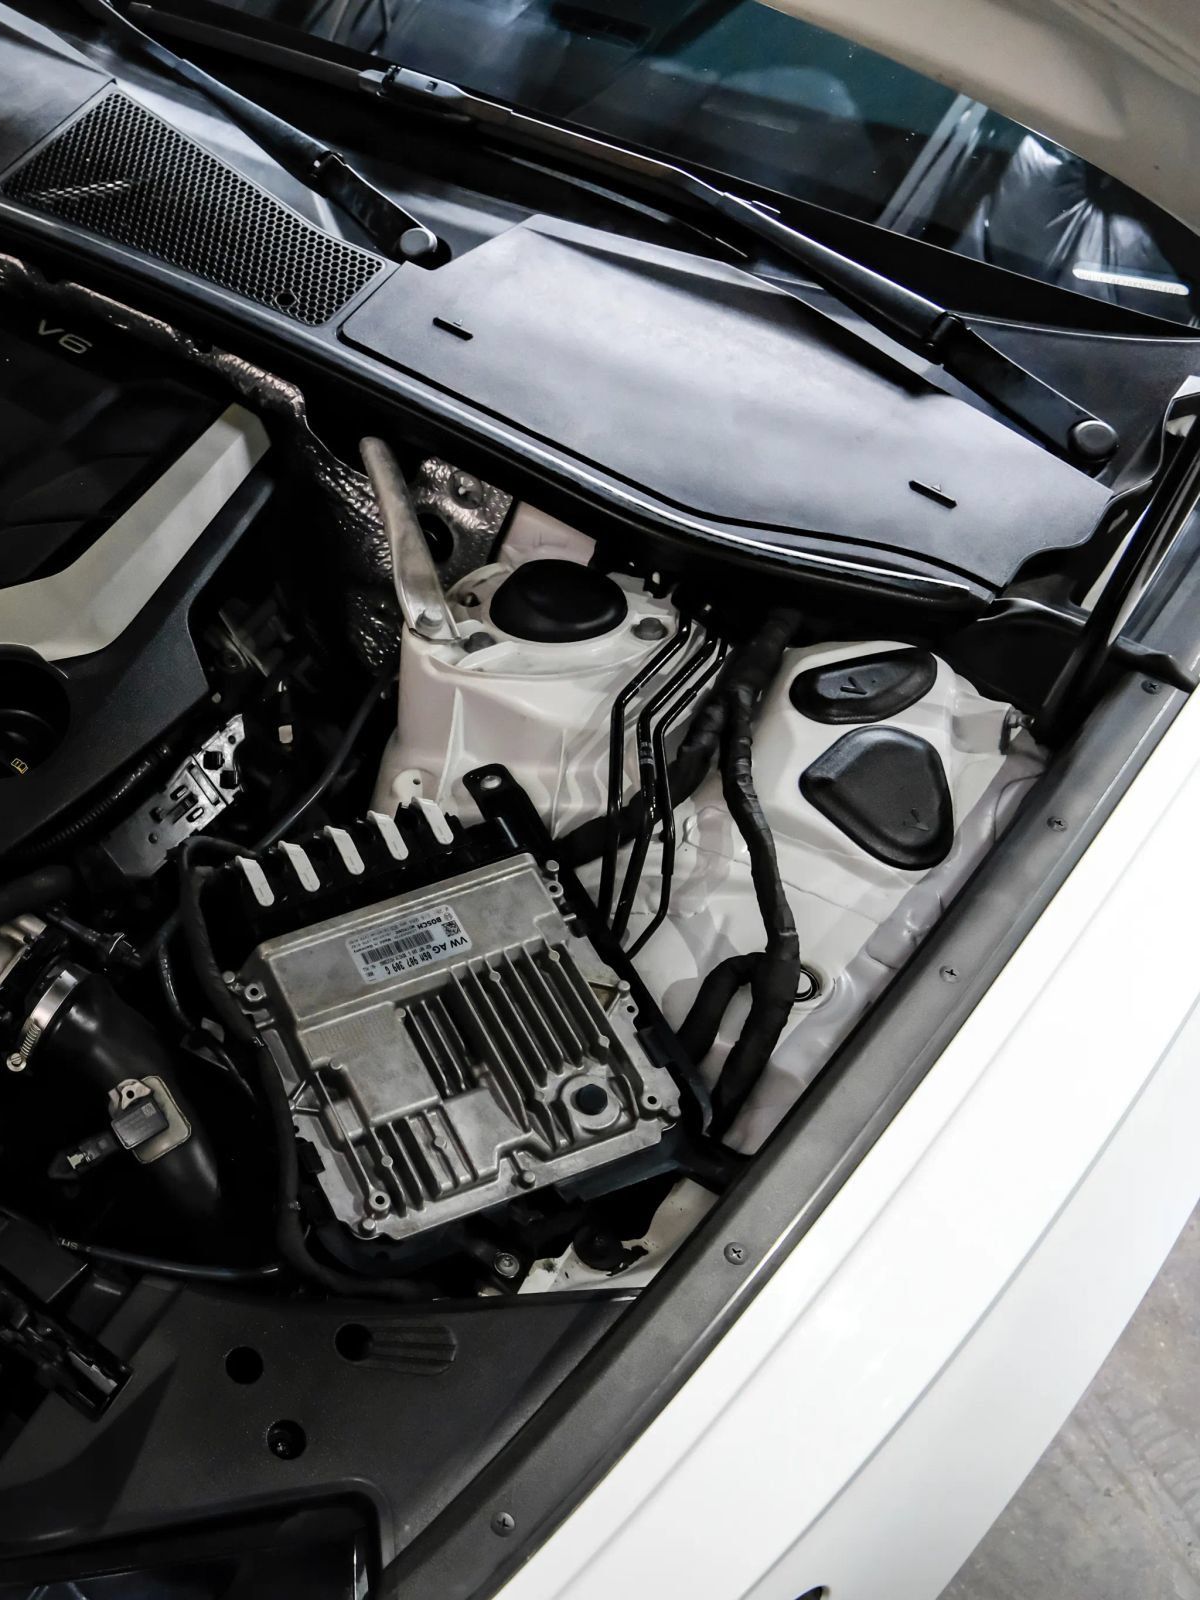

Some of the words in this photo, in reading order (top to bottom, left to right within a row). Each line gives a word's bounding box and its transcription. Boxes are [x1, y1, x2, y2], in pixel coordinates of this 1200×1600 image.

[38, 319, 93, 354] V6
[417, 916, 442, 930] BOSCH
[432, 942, 447, 954] AG
[450, 936, 468, 948] VW
